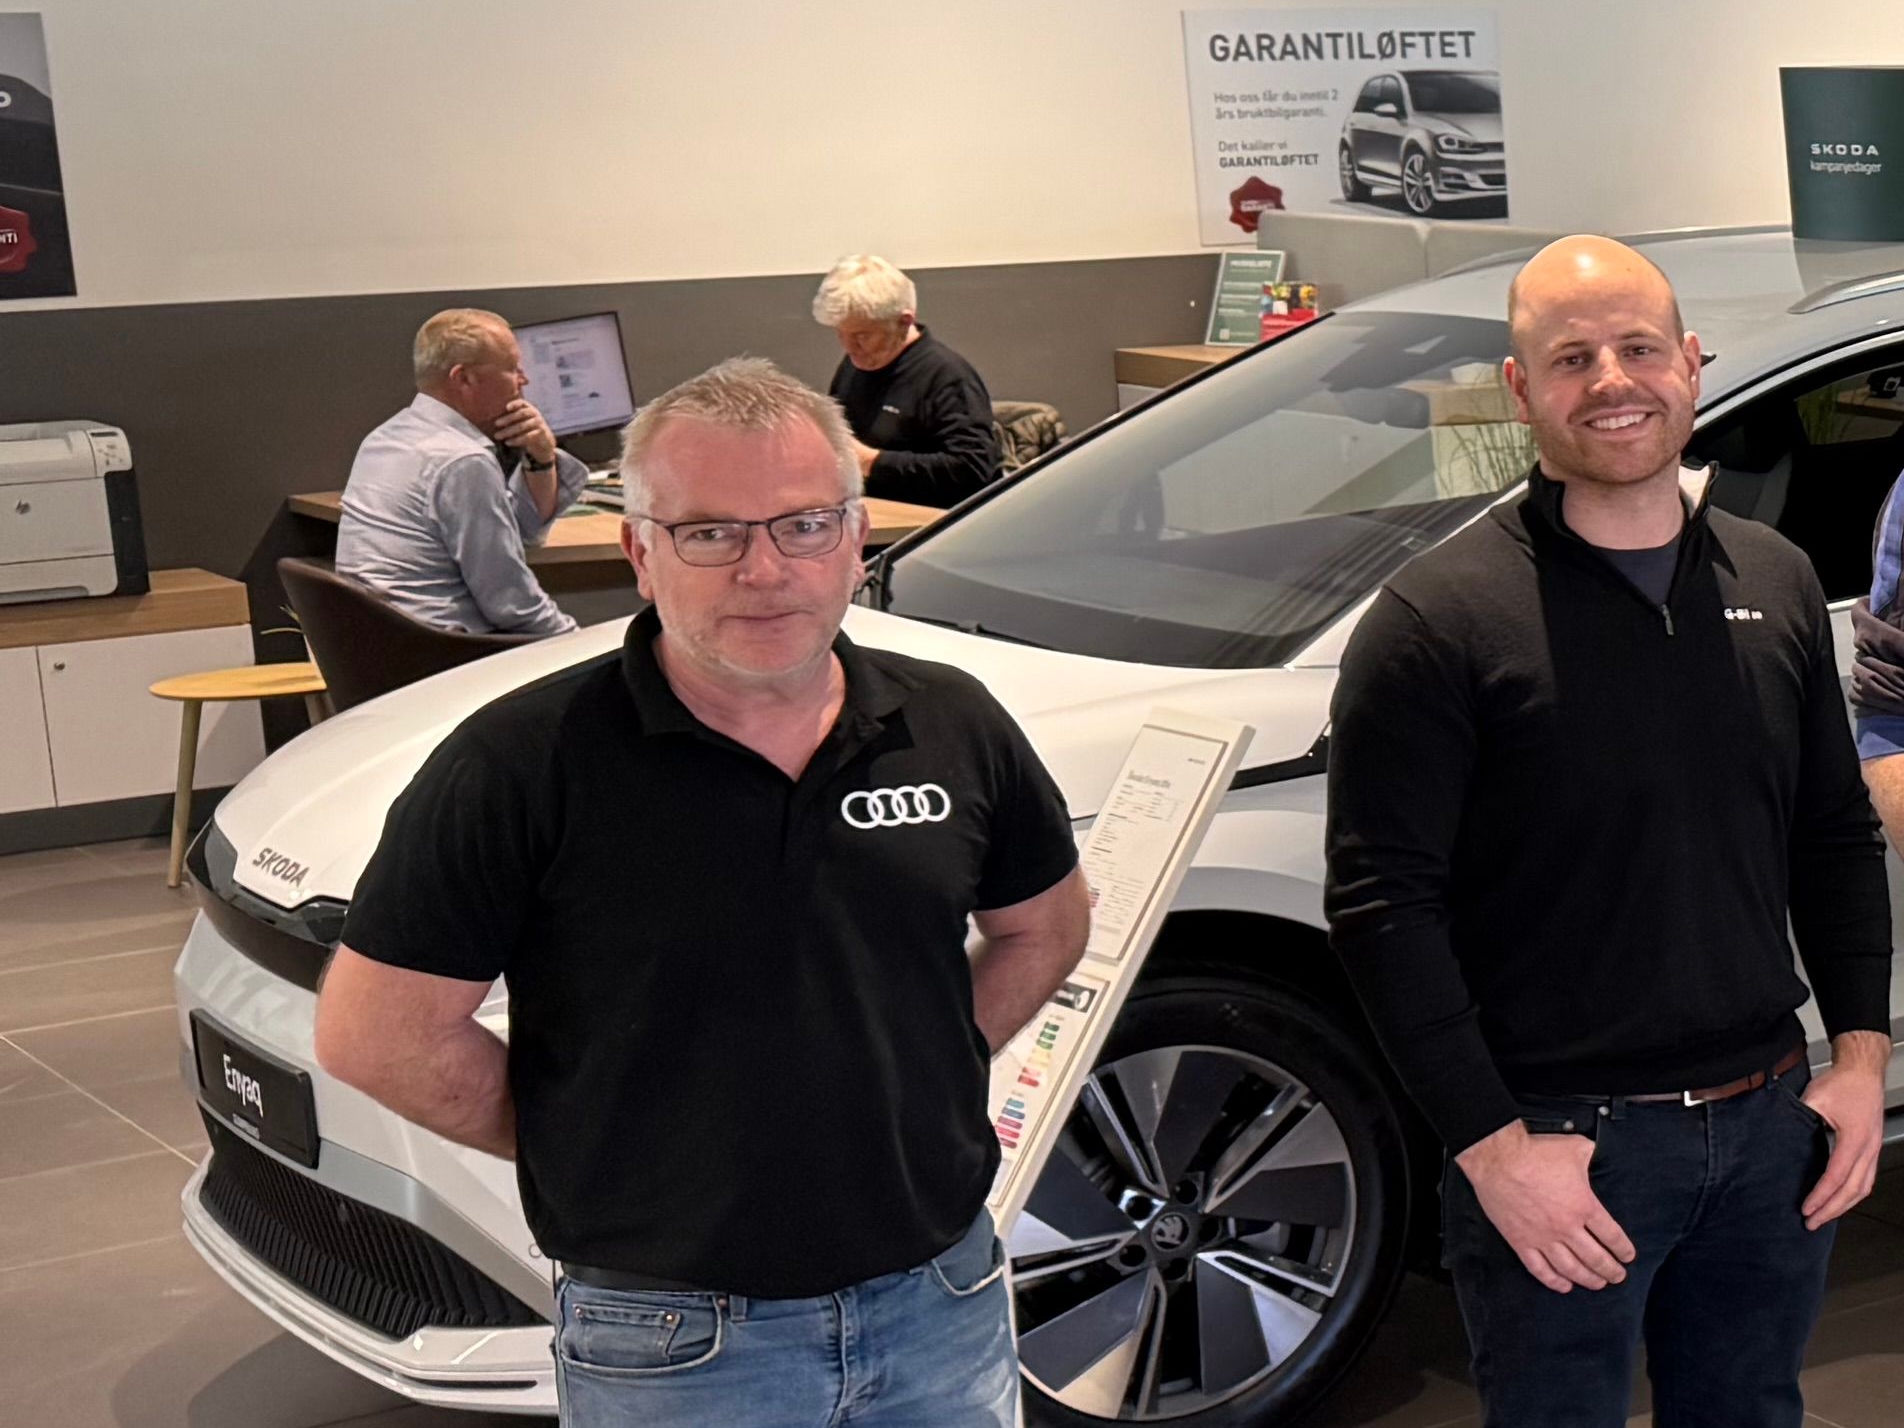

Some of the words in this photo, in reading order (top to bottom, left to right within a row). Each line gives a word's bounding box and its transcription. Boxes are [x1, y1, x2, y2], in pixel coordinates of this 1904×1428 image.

[1209, 30, 1476, 62] GARANTILØFTET
[1219, 154, 1319, 168] GARANTILØFTET
[1810, 143, 1880, 156] SKODA
[252, 847, 310, 888] SKODA
[223, 1053, 264, 1118] Enyaq
